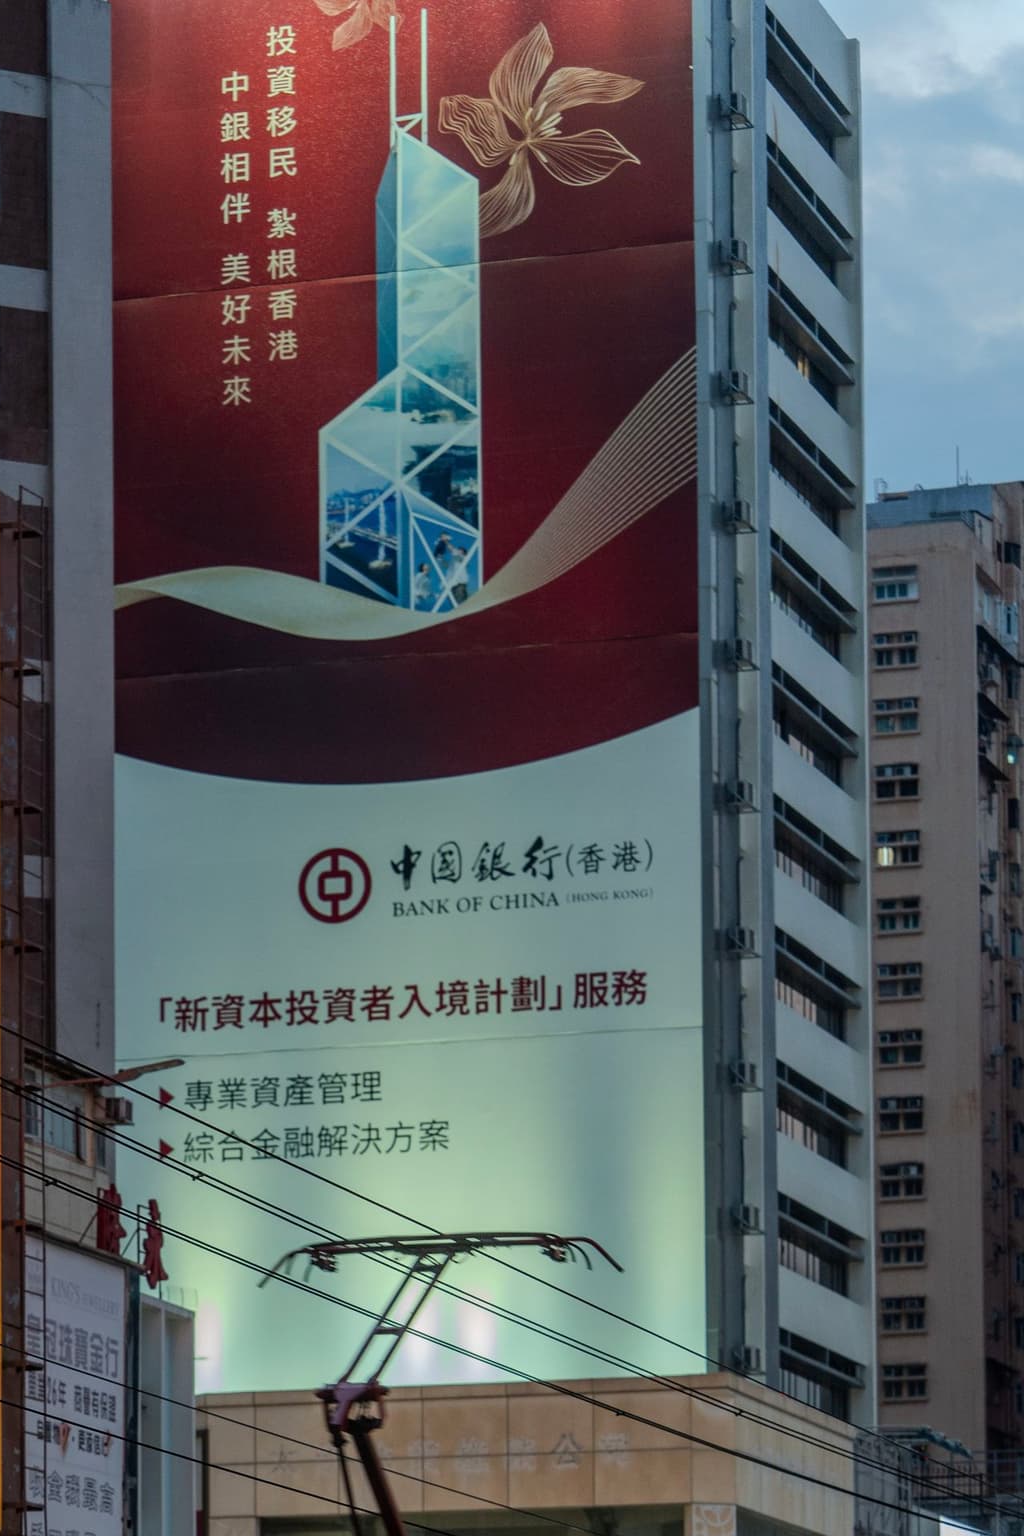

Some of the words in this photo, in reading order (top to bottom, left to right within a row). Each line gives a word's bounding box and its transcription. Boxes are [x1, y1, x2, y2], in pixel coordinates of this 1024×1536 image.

[220, 71, 250, 224] 中銀相伴
[267, 25, 297, 178] 投資移民
[221, 253, 251, 406] 美好未來
[267, 208, 298, 362] 紮根香港
[389, 836, 654, 891] 中國銀行(香港)
[392, 898, 450, 917] BANK
[456, 896, 482, 913] OF
[489, 892, 560, 911] CHINA
[566, 891, 609, 904] (HONG
[612, 887, 654, 901] KONG)
[183, 1120, 450, 1163] 綜合金融解決方案
[184, 1071, 383, 1112] 專業資產管理
